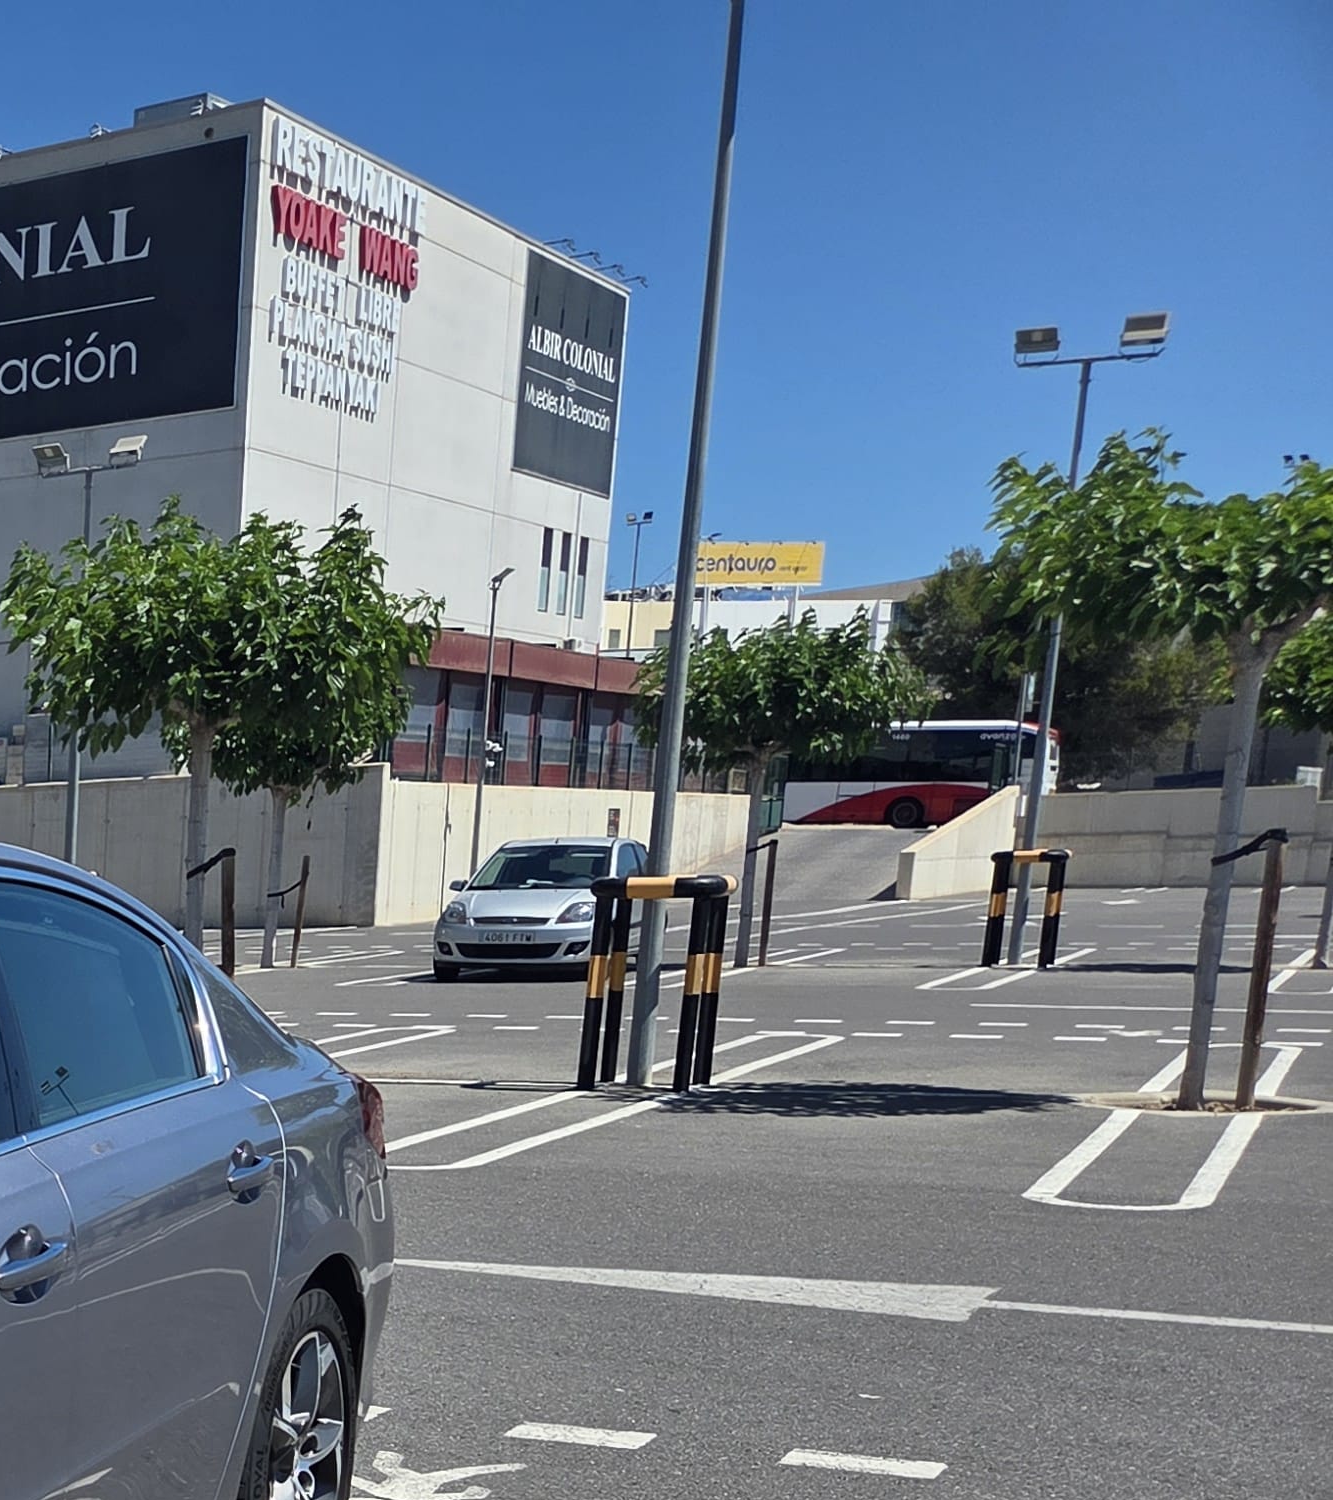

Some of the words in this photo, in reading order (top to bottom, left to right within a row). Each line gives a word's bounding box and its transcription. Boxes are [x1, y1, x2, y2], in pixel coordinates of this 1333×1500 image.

[272, 115, 426, 236] RESTAURANTE
[271, 184, 347, 261] YOAKE
[360, 226, 419, 291] WANG
[270, 296, 347, 354] PLANCHA
[282, 256, 348, 313] BUFFET
[356, 287, 402, 333] LIBRE
[282, 348, 381, 414] TEPPANYAKI
[528, 324, 562, 361] ALBIR
[563, 339, 615, 383] COLONIAL
[525, 381, 558, 414] Muebles
[567, 397, 611, 432] Decoración
